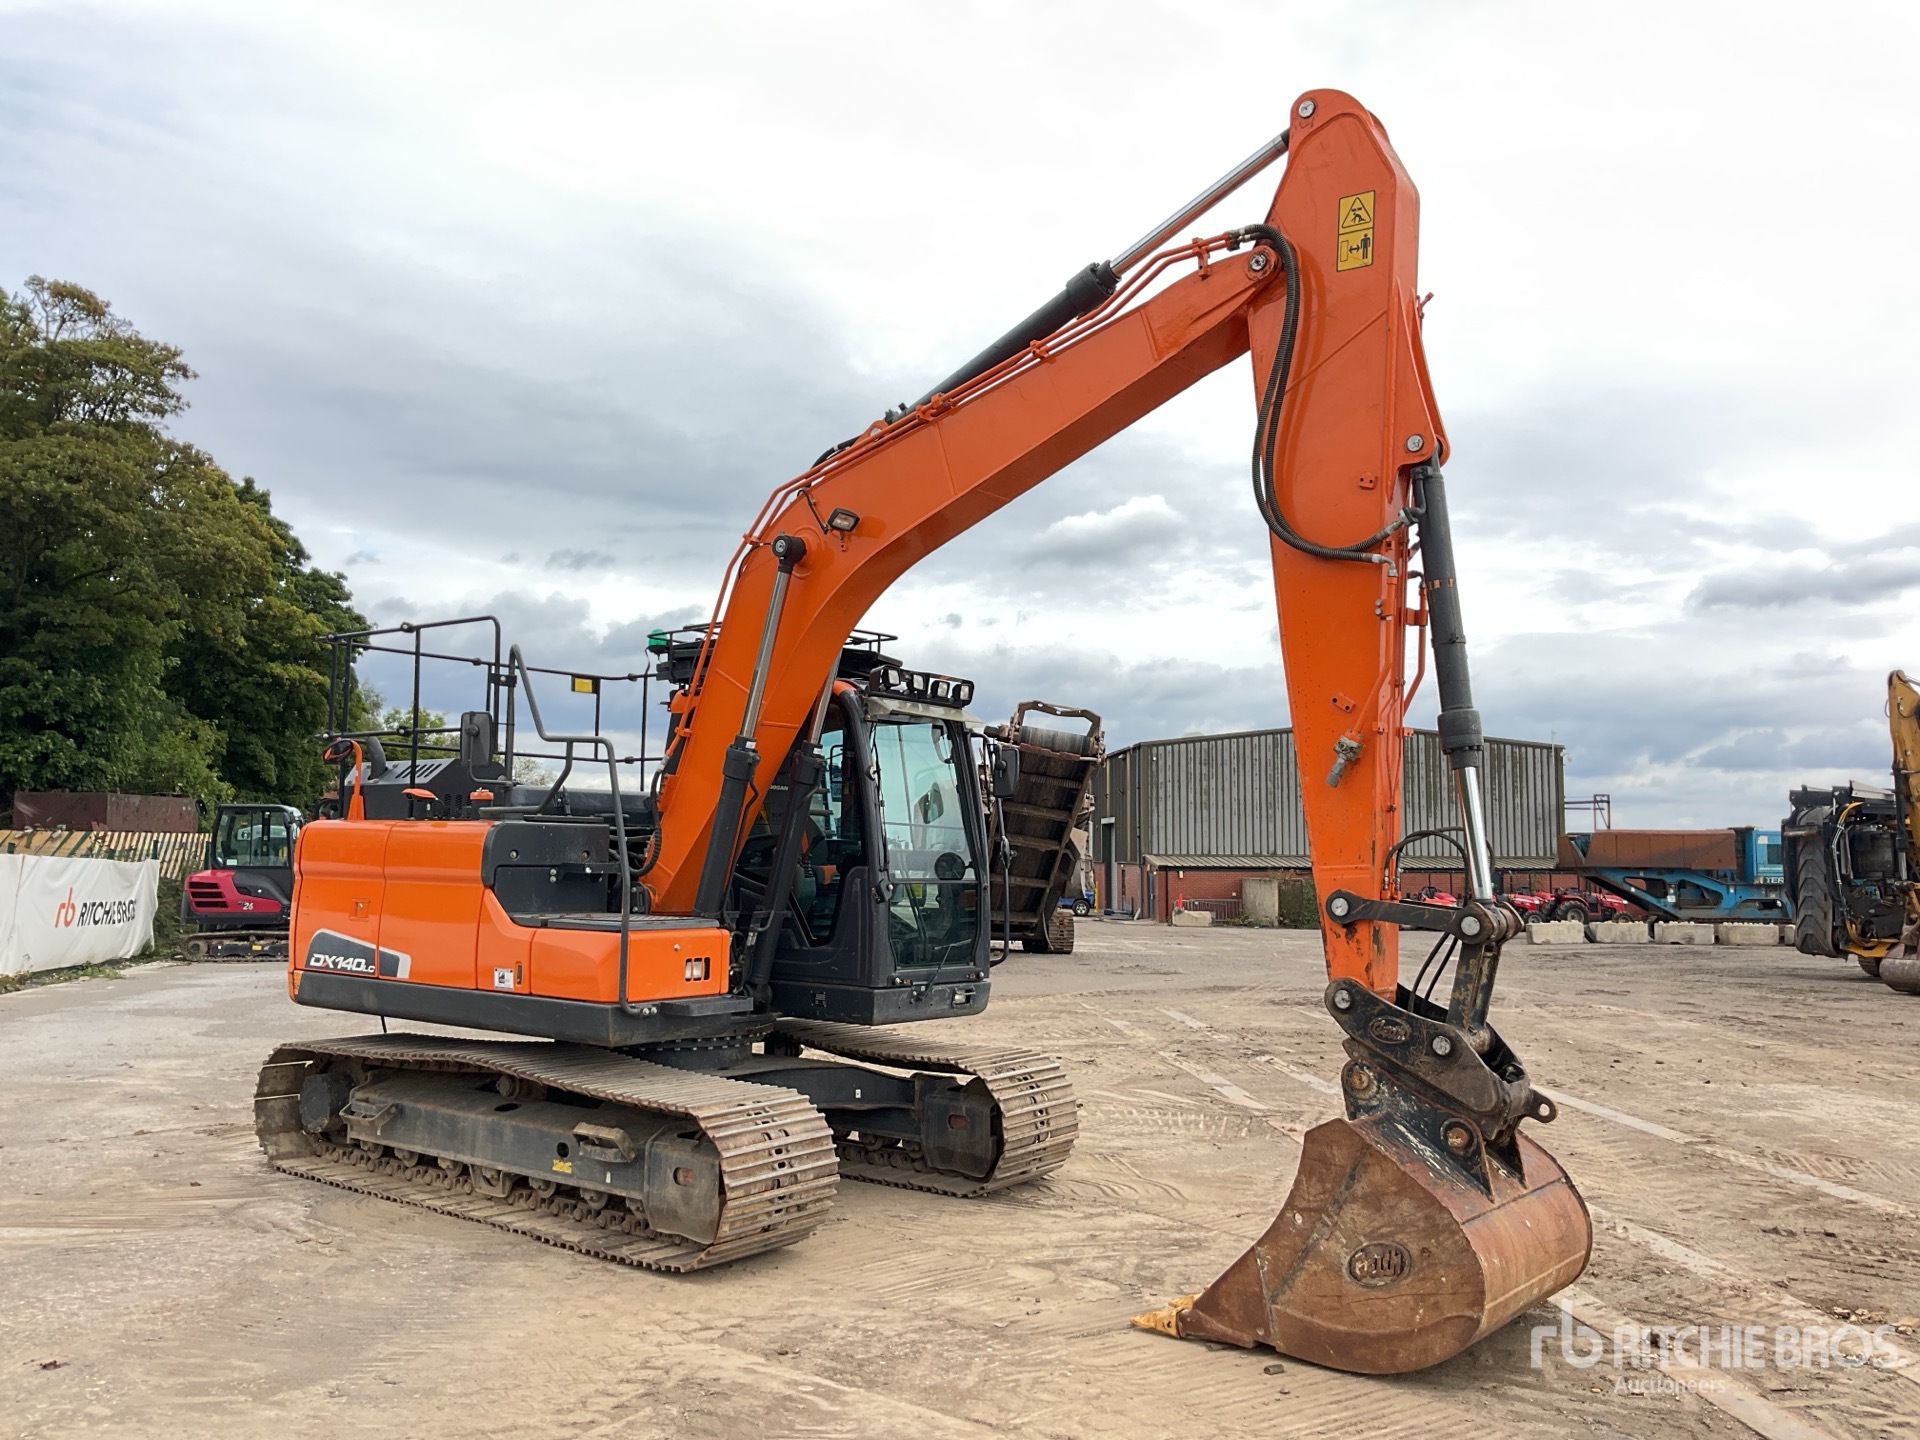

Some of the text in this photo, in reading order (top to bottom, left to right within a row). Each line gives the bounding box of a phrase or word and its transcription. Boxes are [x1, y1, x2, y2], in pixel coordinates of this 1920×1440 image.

[1765, 876, 1784, 884] TER
[54, 887, 75, 930] rb
[77, 901, 116, 928] RITCHIE
